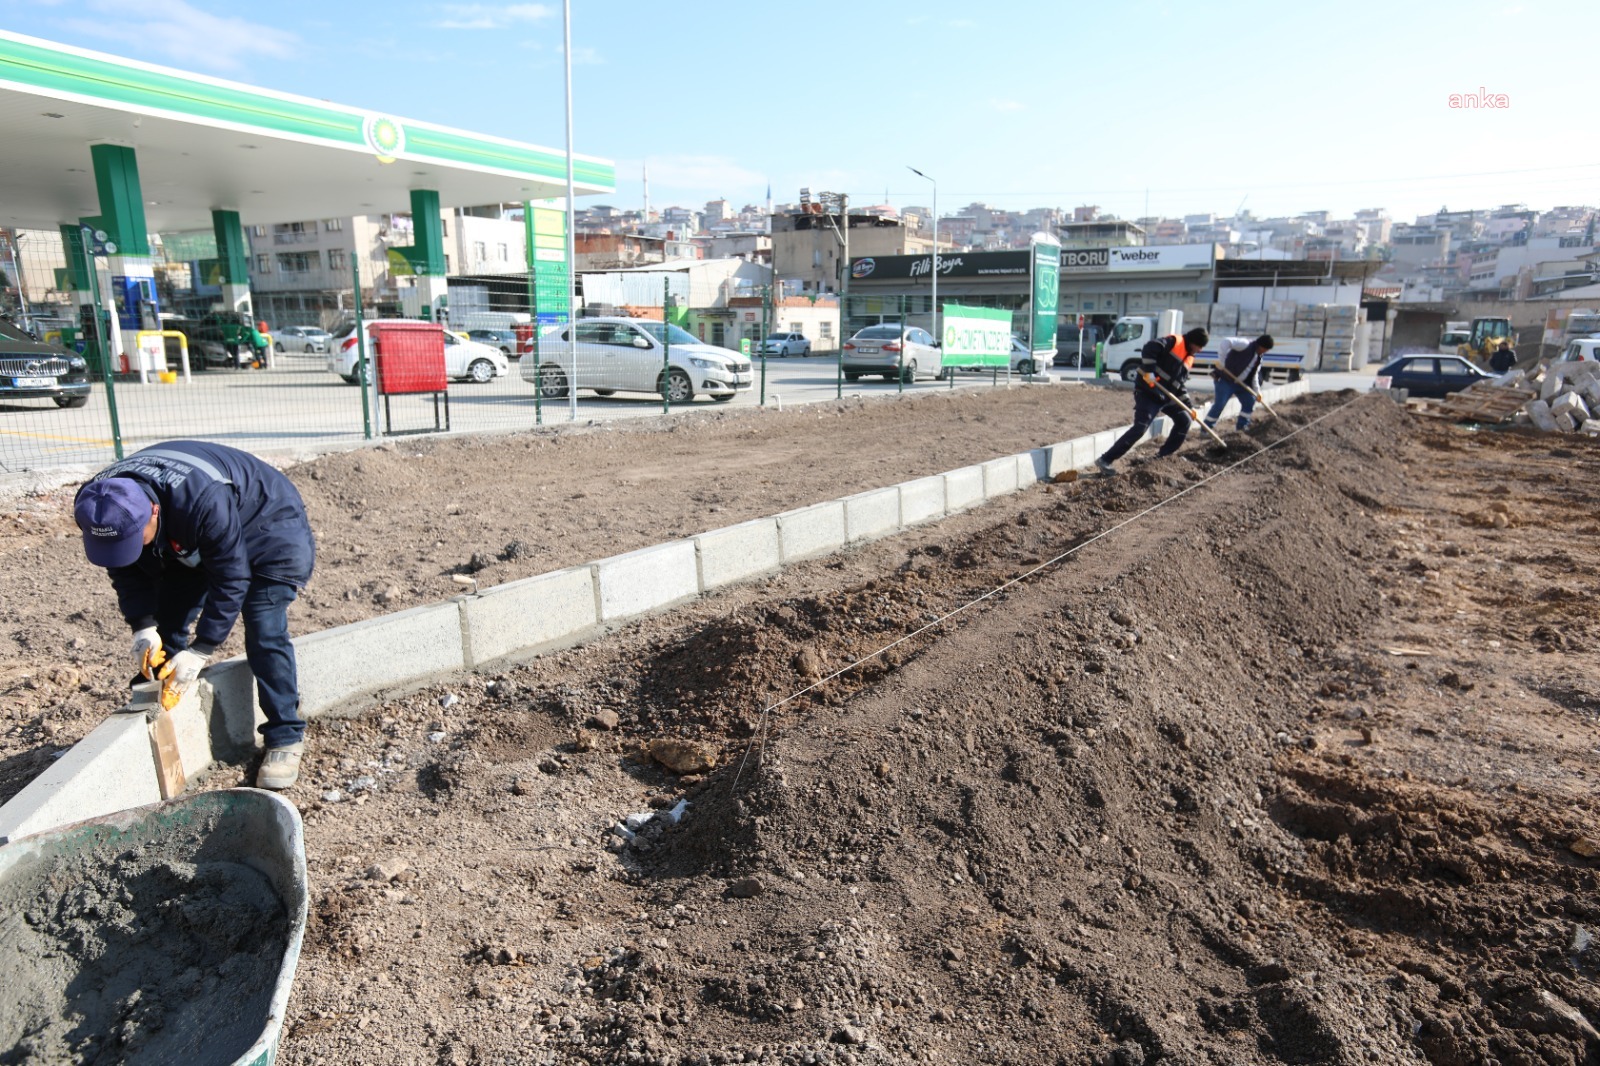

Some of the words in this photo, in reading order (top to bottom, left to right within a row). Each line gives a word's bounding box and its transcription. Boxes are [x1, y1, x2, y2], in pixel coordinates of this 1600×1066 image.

[1120, 248, 1160, 261] weber
[909, 257, 932, 277] Filli
[935, 255, 964, 274] Boya
